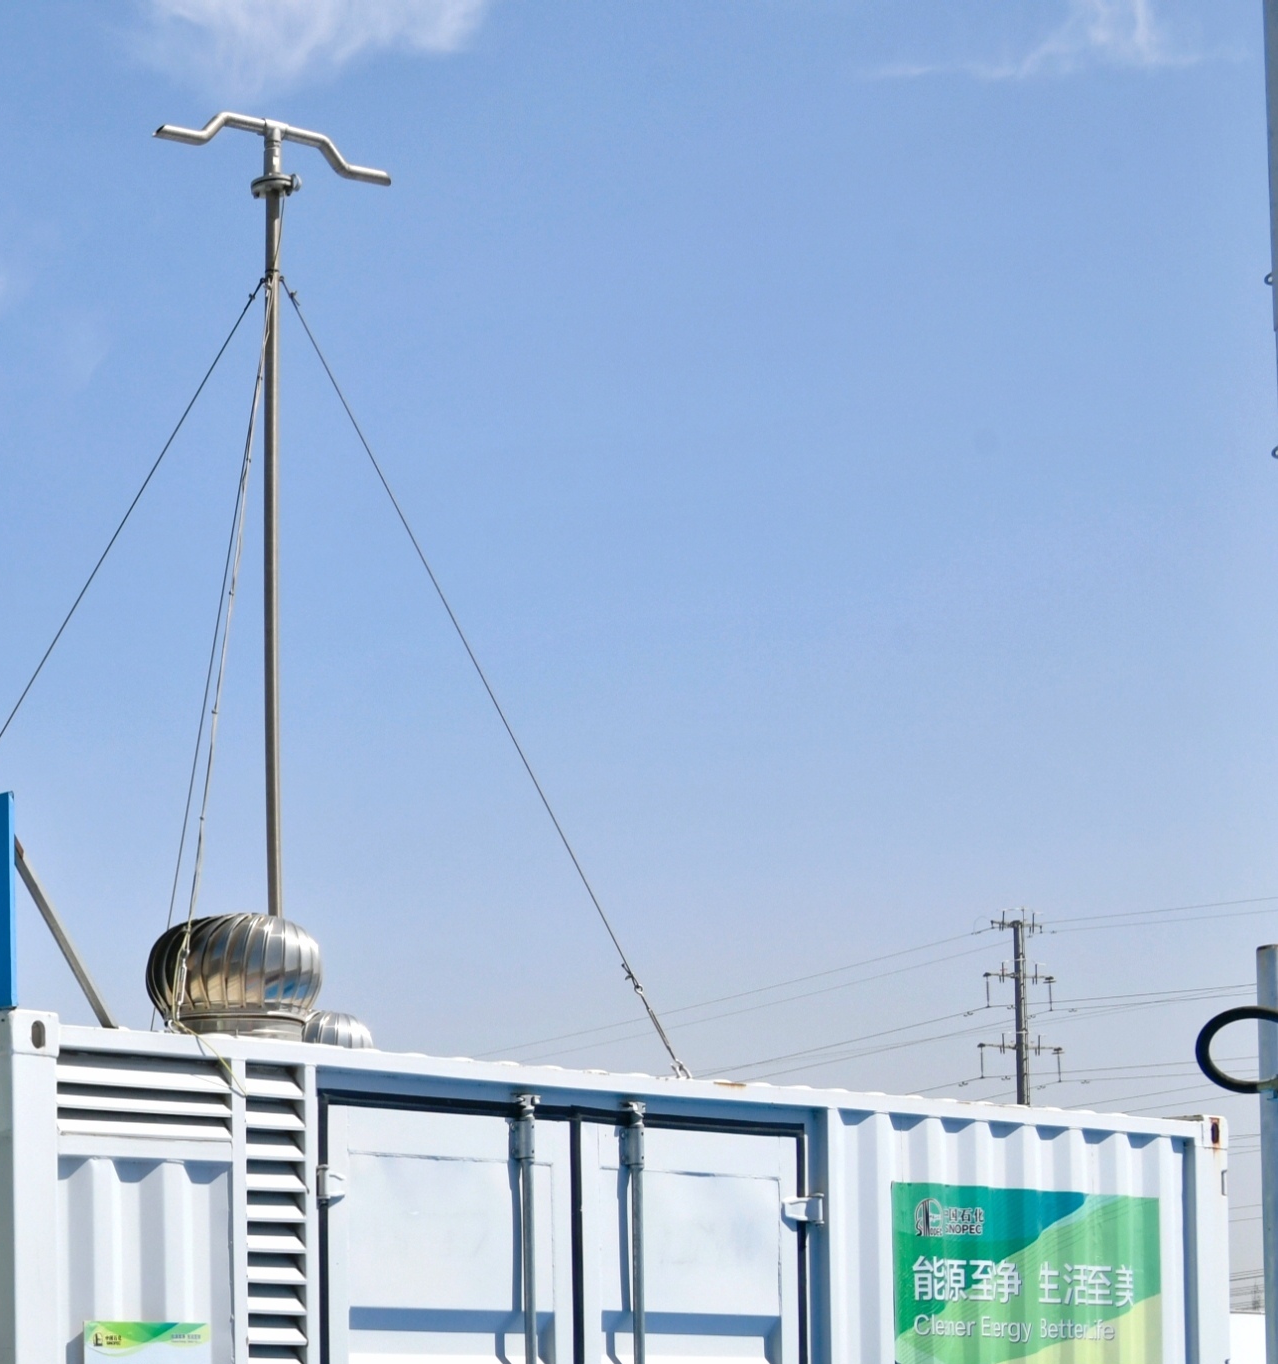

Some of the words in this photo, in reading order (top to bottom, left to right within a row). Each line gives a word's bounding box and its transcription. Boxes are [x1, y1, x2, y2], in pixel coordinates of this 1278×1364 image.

[945, 1224, 982, 1235] SNOPEC
[912, 1255, 1022, 1304] 能源至净
[1039, 1261, 1135, 1307] 生活至美
[981, 1316, 1032, 1343] Eergy
